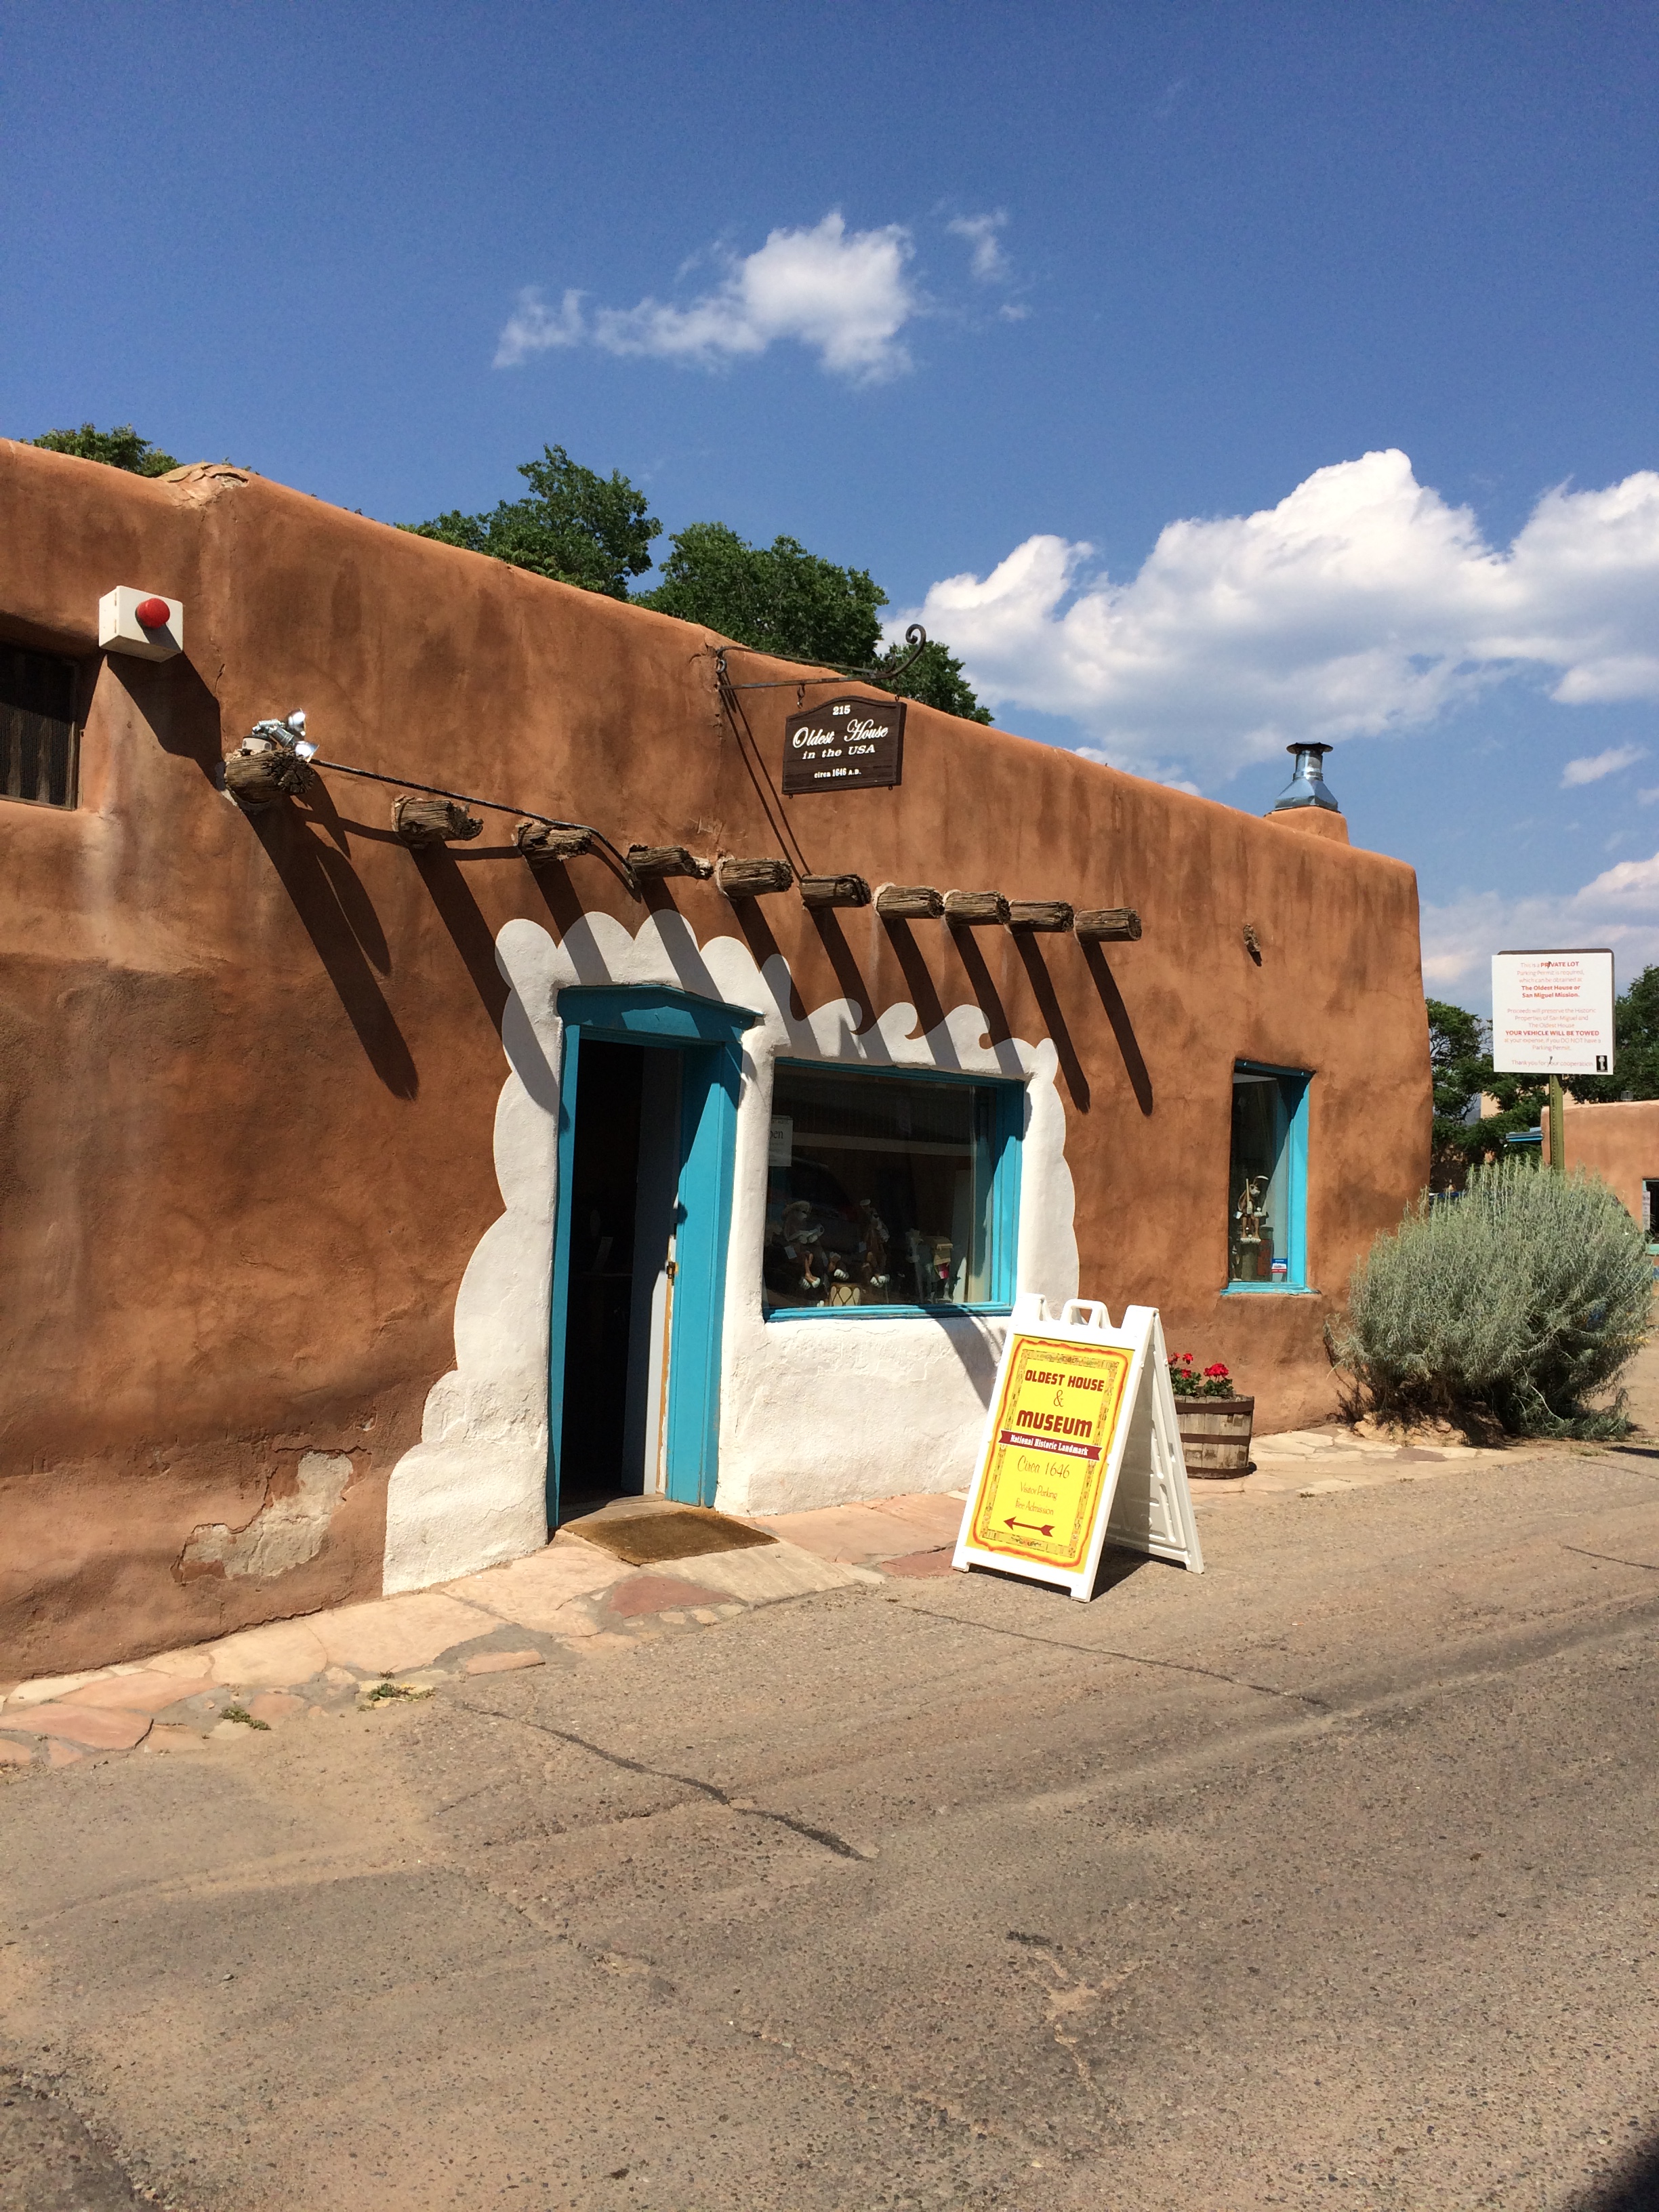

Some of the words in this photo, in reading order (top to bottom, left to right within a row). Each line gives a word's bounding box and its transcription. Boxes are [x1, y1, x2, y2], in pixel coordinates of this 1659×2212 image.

[832, 705, 851, 716] 215
[792, 726, 835, 748] Oldest
[844, 719, 888, 742] House
[802, 750, 815, 760] in
[821, 748, 842, 758] the
[848, 744, 876, 755] USA
[814, 770, 831, 778] circa
[832, 768, 847, 777] 1646
[1025, 1369, 1066, 1386] OLDEST
[1067, 1375, 1105, 1392] HOUSE
[1053, 1389, 1064, 1408] &
[1016, 1410, 1093, 1438] MUSEUM
[1010, 1434, 1034, 1446] National
[1034, 1438, 1057, 1450] Historic
[1058, 1443, 1089, 1456] Landmark
[1017, 1455, 1040, 1473] Circa
[1045, 1462, 1070, 1479] 1646
[1020, 1481, 1037, 1495] Visitor
[1037, 1485, 1058, 1501] Parking
[1026, 1500, 1054, 1515] Admission
